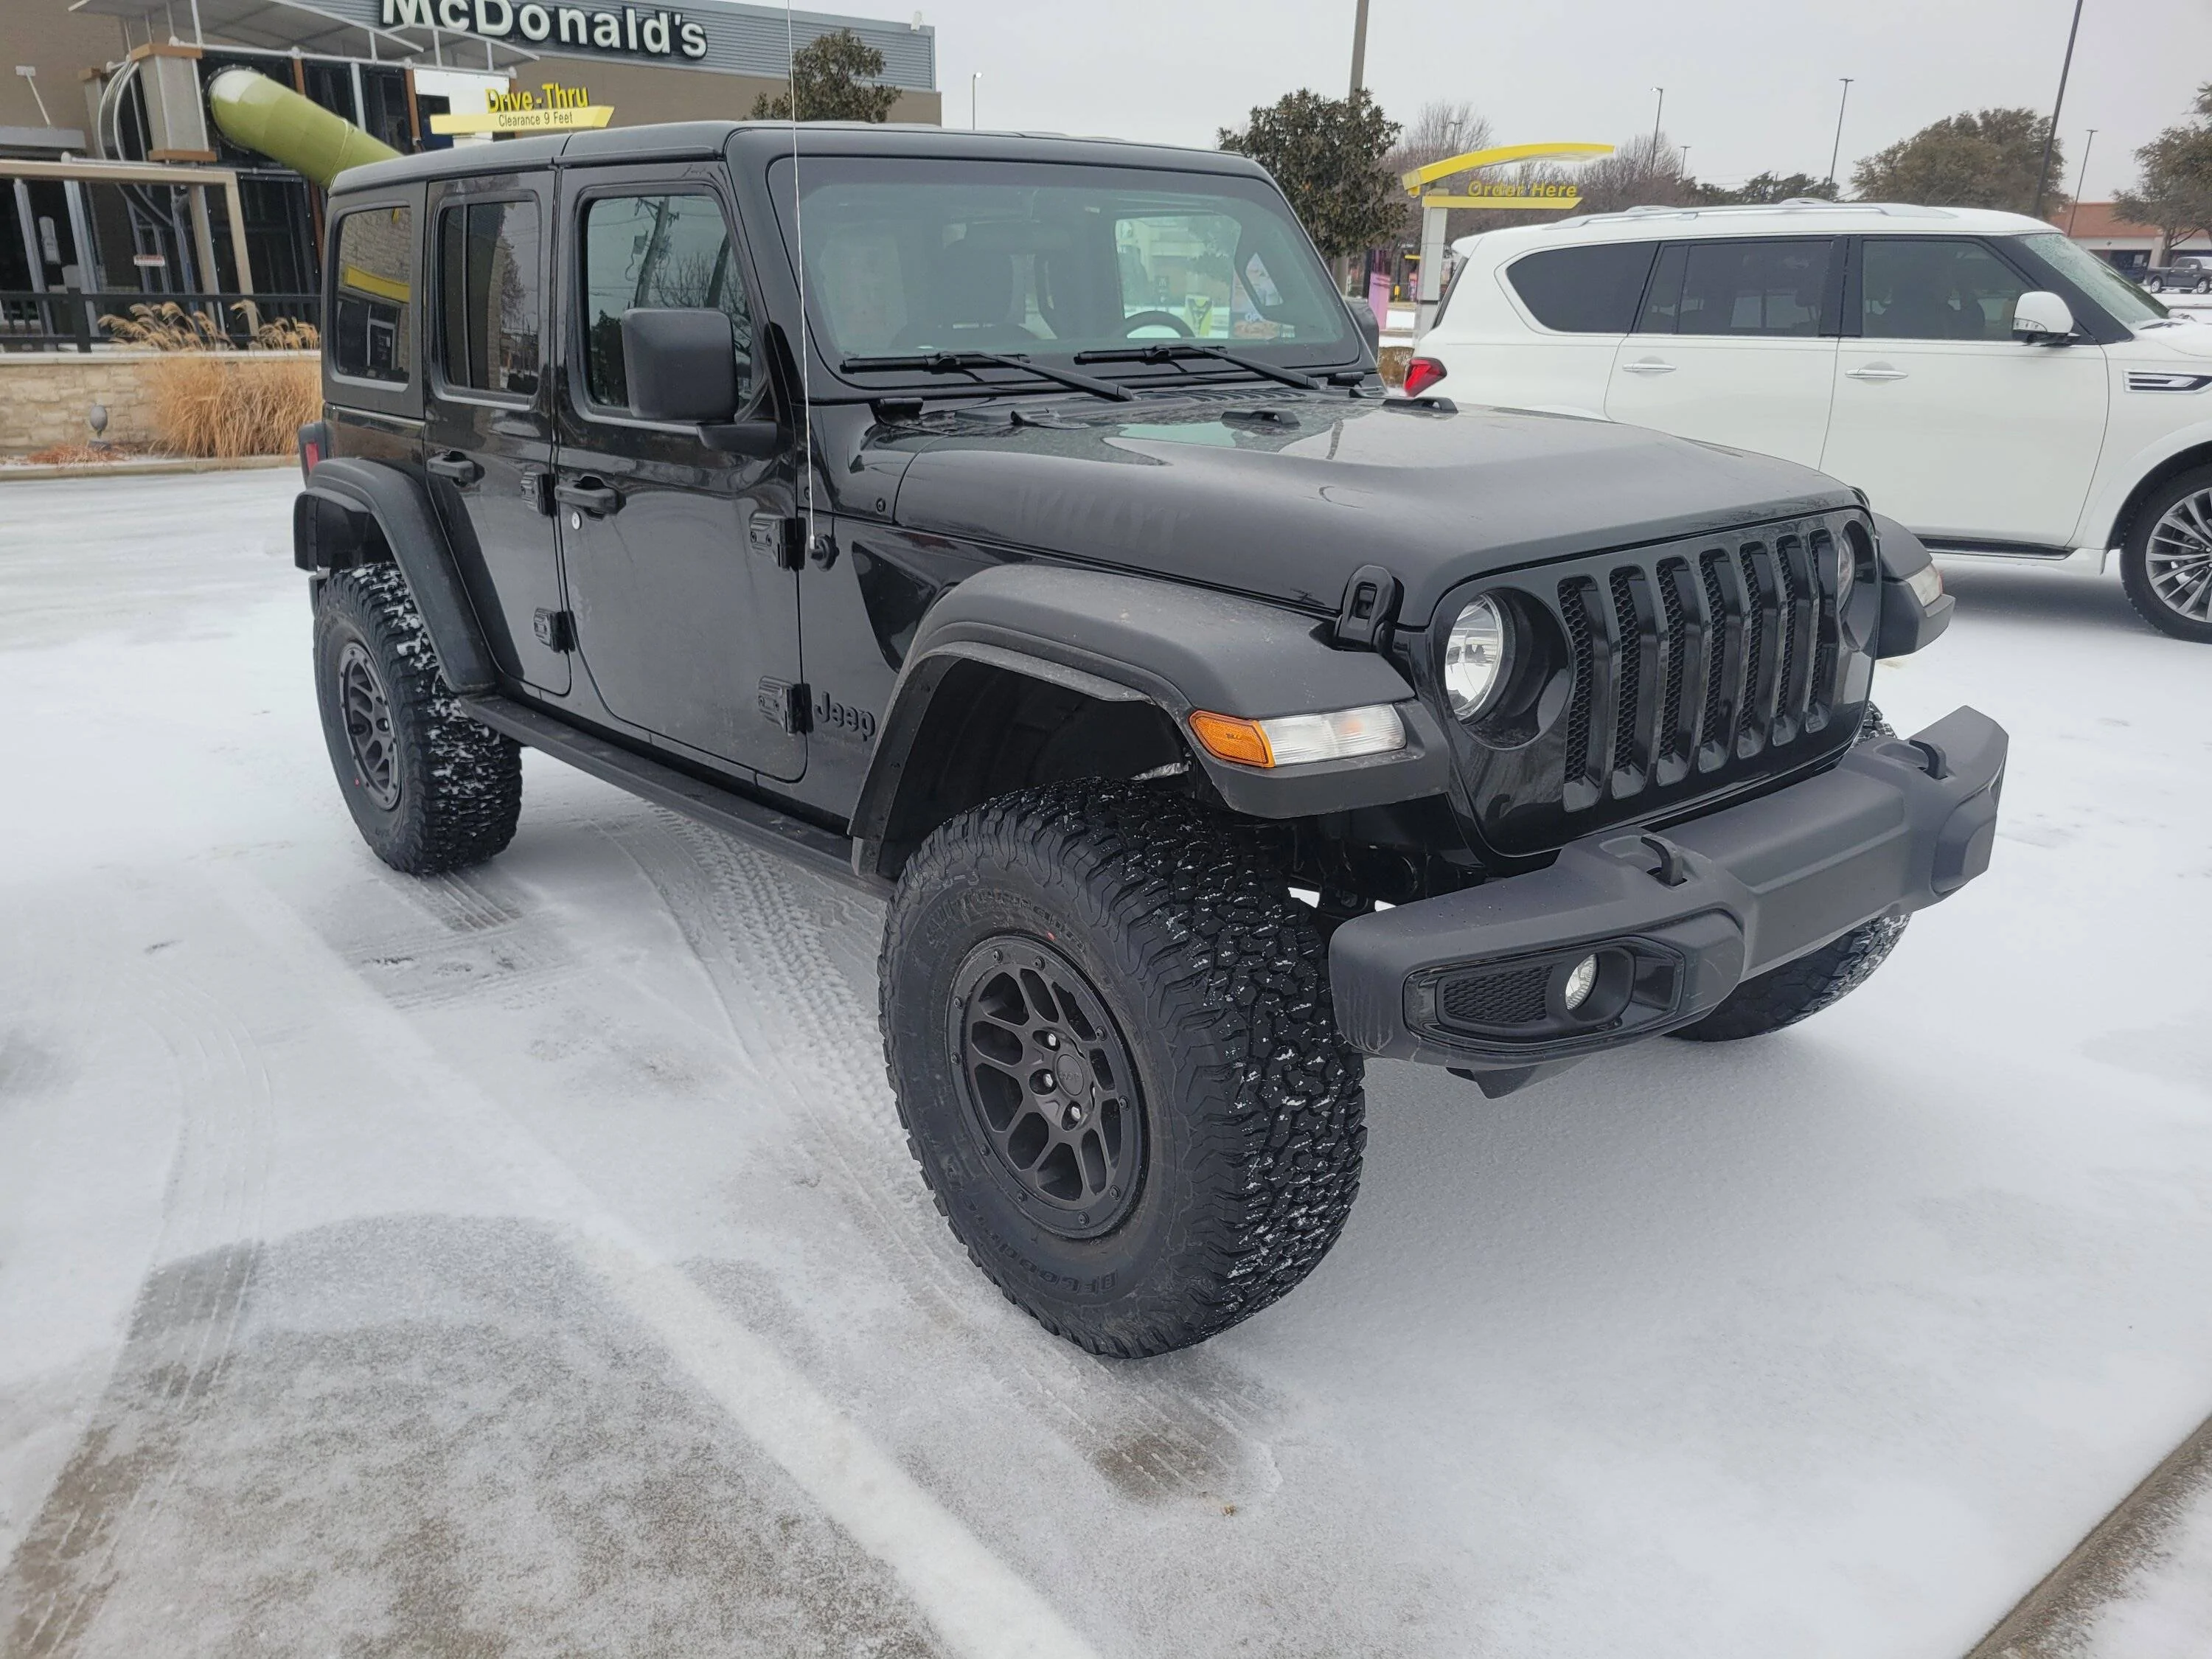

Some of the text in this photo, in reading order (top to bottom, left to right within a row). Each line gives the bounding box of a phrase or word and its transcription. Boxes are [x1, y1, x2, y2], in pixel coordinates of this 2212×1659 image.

[383, 0, 707, 58] McDonald's
[499, 111, 573, 127] Clearance 9 Feet
[1468, 181, 1577, 197] Order Here
[813, 691, 876, 741] Jeep
